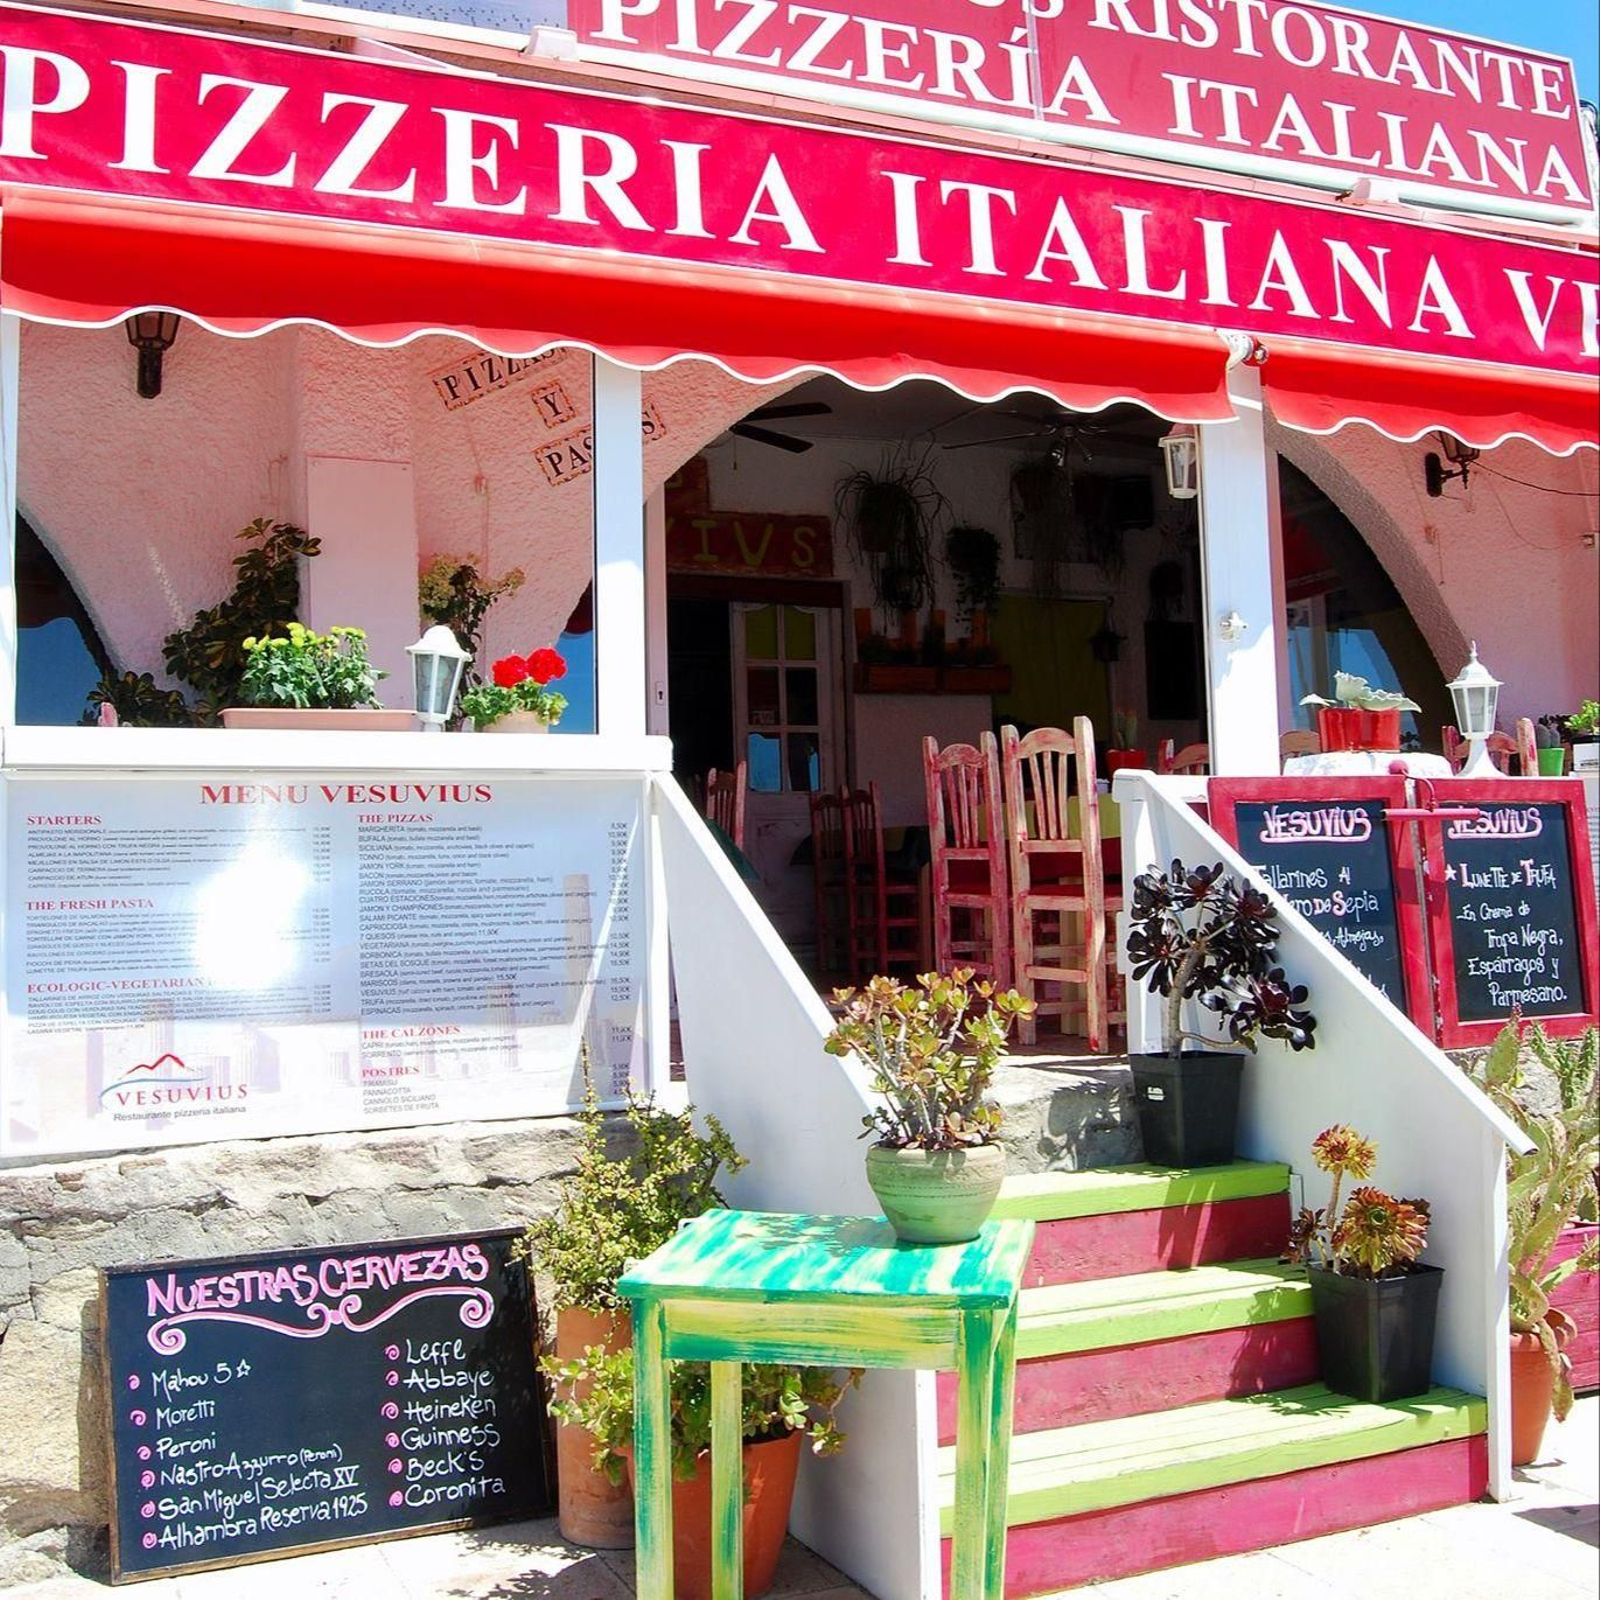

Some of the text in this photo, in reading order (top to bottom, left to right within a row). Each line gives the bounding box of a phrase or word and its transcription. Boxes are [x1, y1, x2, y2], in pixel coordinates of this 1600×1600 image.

[1162, 72, 1591, 204] ITALIANA
[0, 44, 825, 254] PIZZERIA
[881, 170, 1475, 339] ITALIANA
[442, 346, 556, 402] PIZZ
[541, 391, 562, 418] Y
[667, 517, 817, 567] IVS
[200, 783, 493, 804] MENU VESUVIUS
[27, 815, 102, 826] STARTERS
[358, 814, 434, 823] THE PIZZAS
[1260, 804, 1372, 843] VESUVIUS
[1448, 806, 1543, 839] VESUVIUS
[26, 899, 154, 911] THE FRESH PASTA
[1332, 890, 1379, 923] Sepia
[1521, 923, 1564, 957] Negra,
[1467, 956, 1560, 986] Espárragos y
[1488, 981, 1569, 1007] Parmesano.
[363, 1026, 461, 1040] THE CALZONES
[362, 1066, 420, 1078] POSTRES
[116, 1084, 249, 1107] VESUVIUS
[113, 1109, 172, 1122] Restaurante
[146, 1243, 490, 1317] NUESTRAS CERVEZAS
[405, 1338, 466, 1366] Leffe
[151, 1361, 233, 1402] Mahou 5
[402, 1367, 496, 1399] Abbaye
[155, 1400, 217, 1432] Moretti
[402, 1397, 497, 1425] Heineken
[155, 1431, 218, 1461] Peroni
[400, 1423, 501, 1452] Guinness
[157, 1498, 203, 1521] San
[203, 1481, 261, 1519] Miguel
[404, 1475, 507, 1508] Coronita
[157, 1492, 369, 1551] Alhambra Reserva 1925
